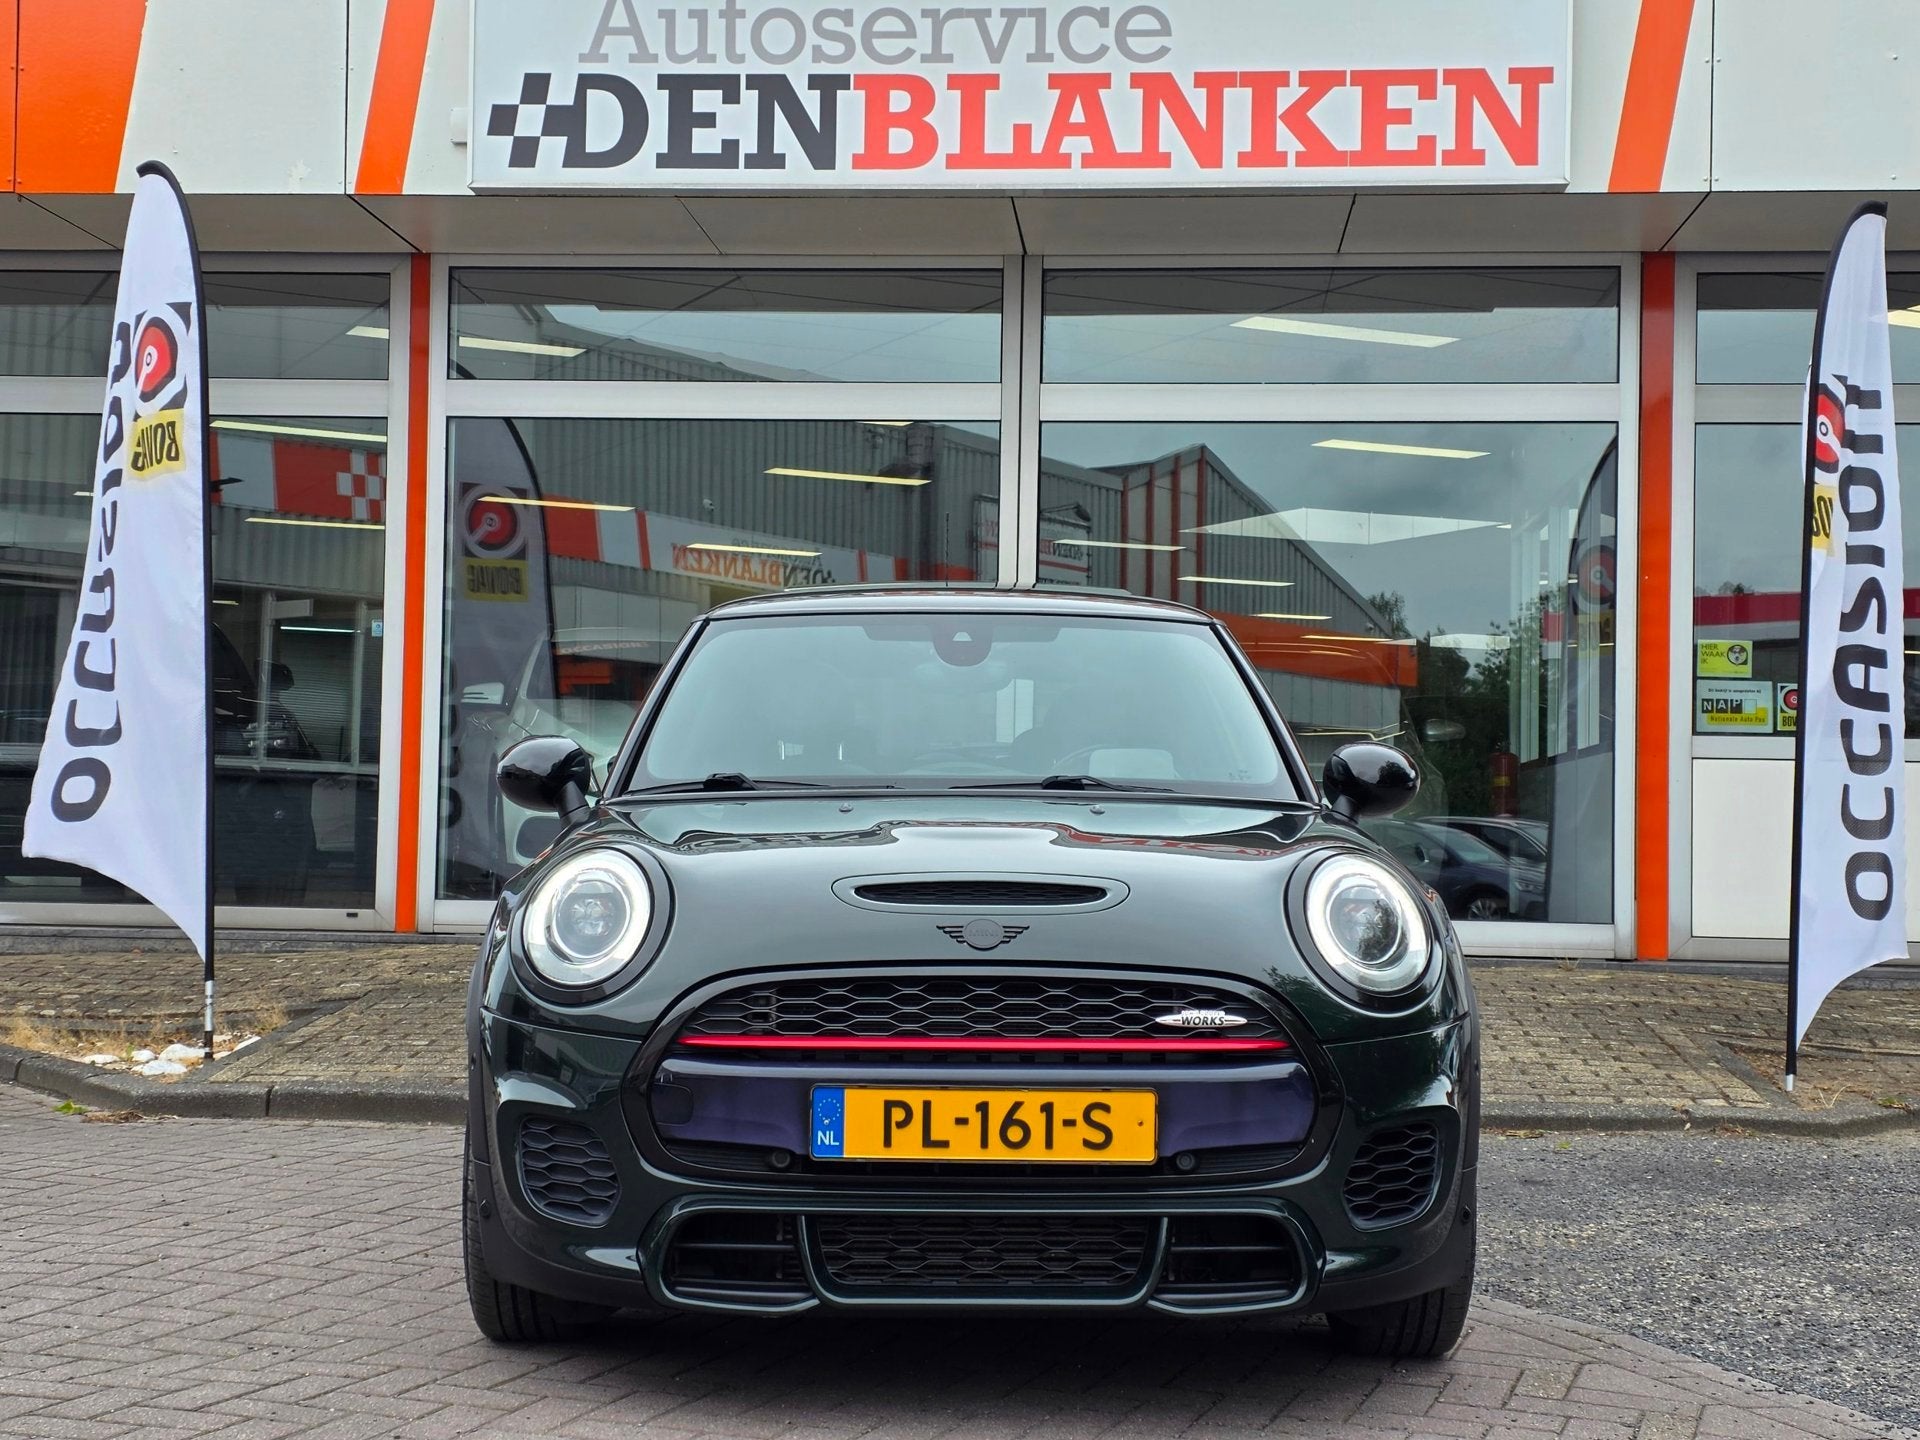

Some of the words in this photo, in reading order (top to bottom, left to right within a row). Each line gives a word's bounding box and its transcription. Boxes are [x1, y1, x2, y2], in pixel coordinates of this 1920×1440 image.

[578, 0, 1172, 65] Autoservice
[562, 67, 1554, 170] DENBLANKEN
[1702, 699, 1741, 711] NAP
[1782, 716, 1797, 726] BOV
[1181, 1016, 1225, 1026] WORKS
[817, 1130, 839, 1146] NL
[883, 1100, 1114, 1150] PL-161-S
